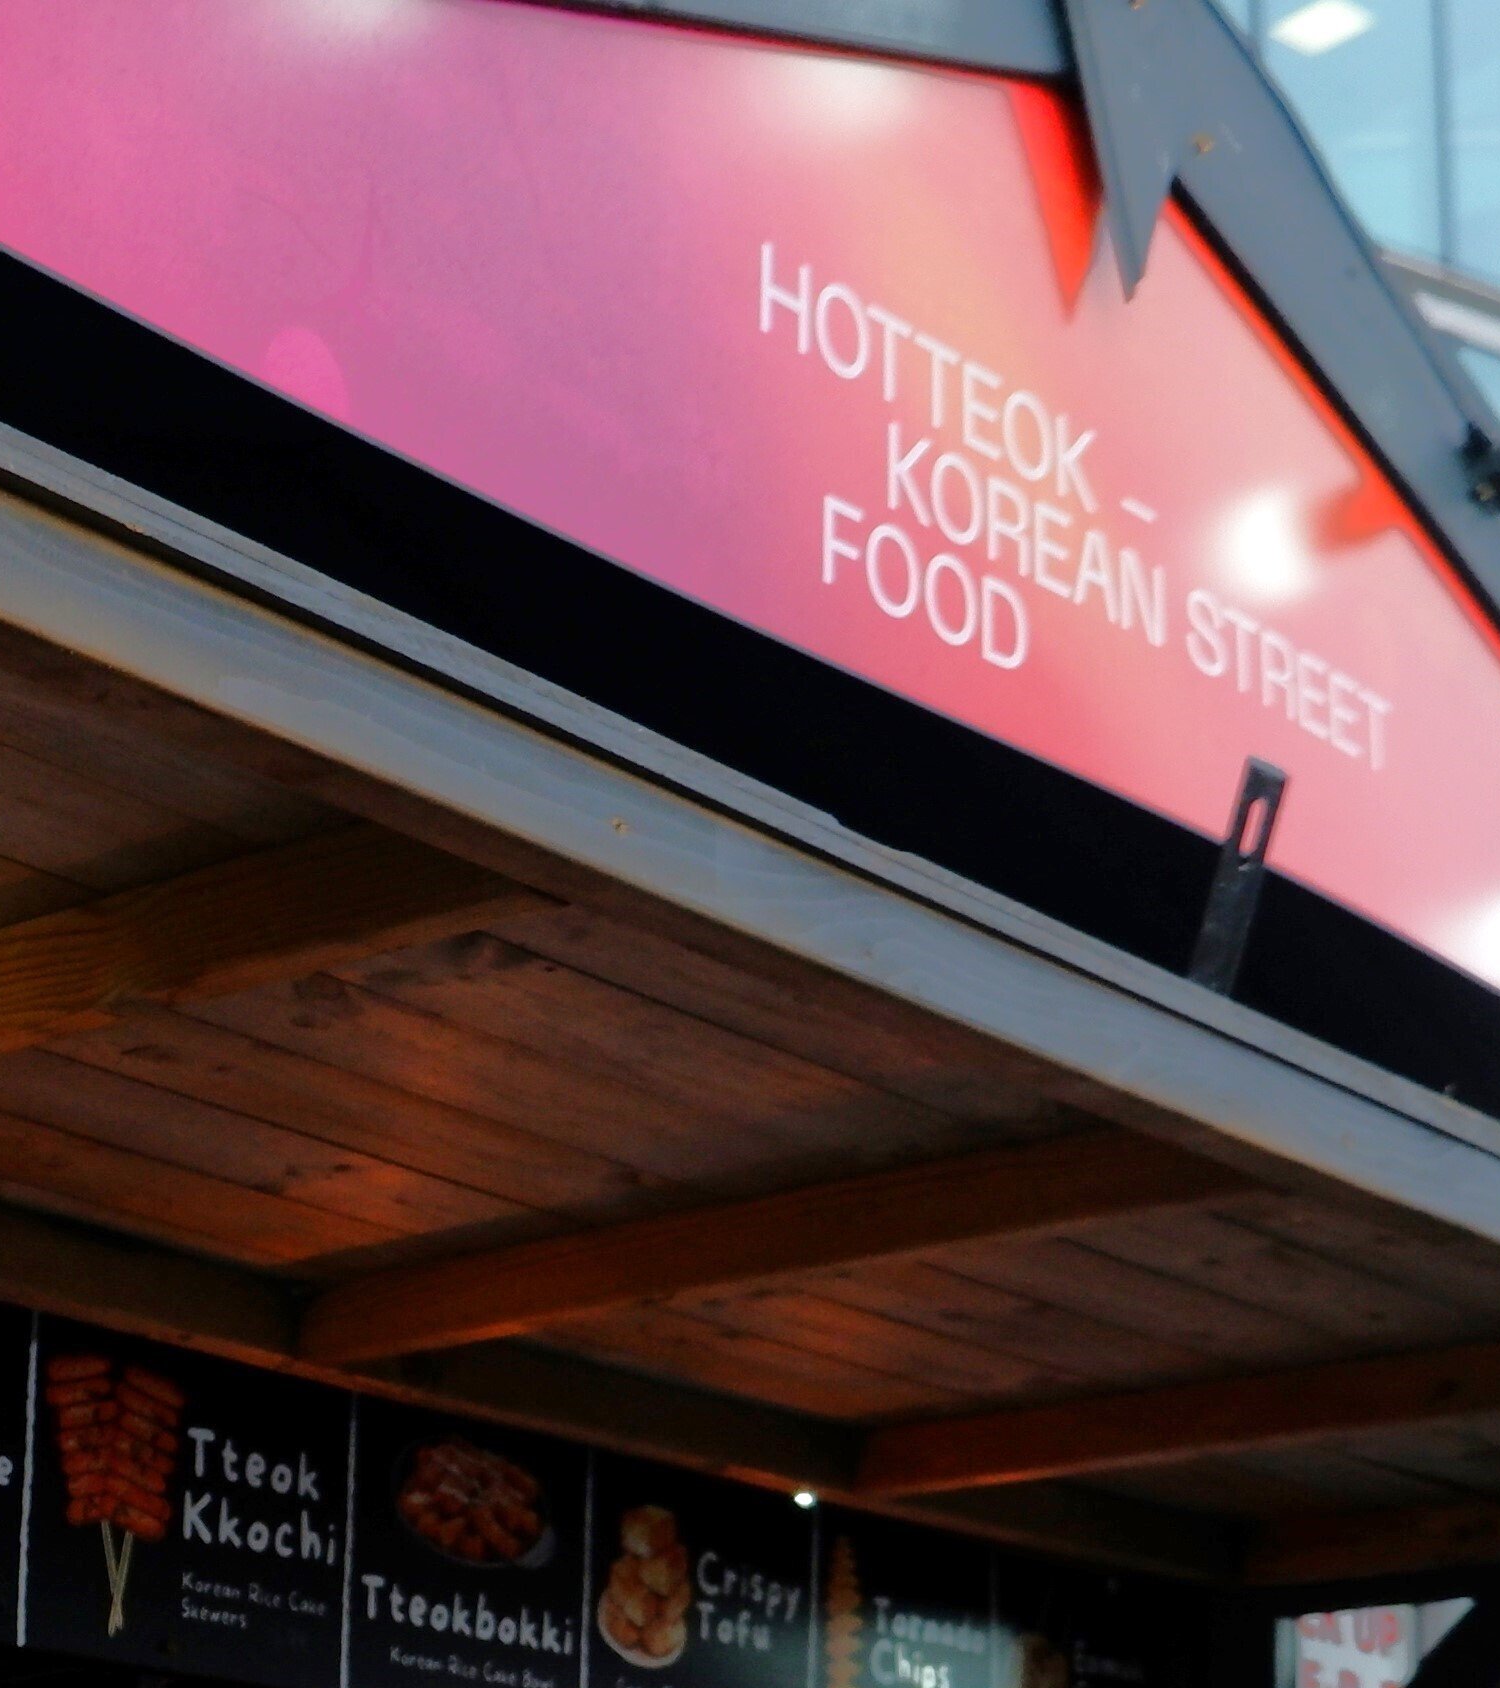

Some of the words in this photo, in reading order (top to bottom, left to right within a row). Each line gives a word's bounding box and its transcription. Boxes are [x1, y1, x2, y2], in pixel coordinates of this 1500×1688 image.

[759, 240, 1098, 513] HOTTEOK
[822, 495, 1028, 669] FOOD
[886, 422, 1167, 647] KOREAN
[1185, 589, 1394, 771] STREET
[187, 1427, 320, 1501] Tteok
[181, 1490, 338, 1566] Kkochi
[361, 1573, 574, 1656] Tteokbokki
[696, 1550, 801, 1622] Crispy
[696, 1601, 771, 1652] Tofu
